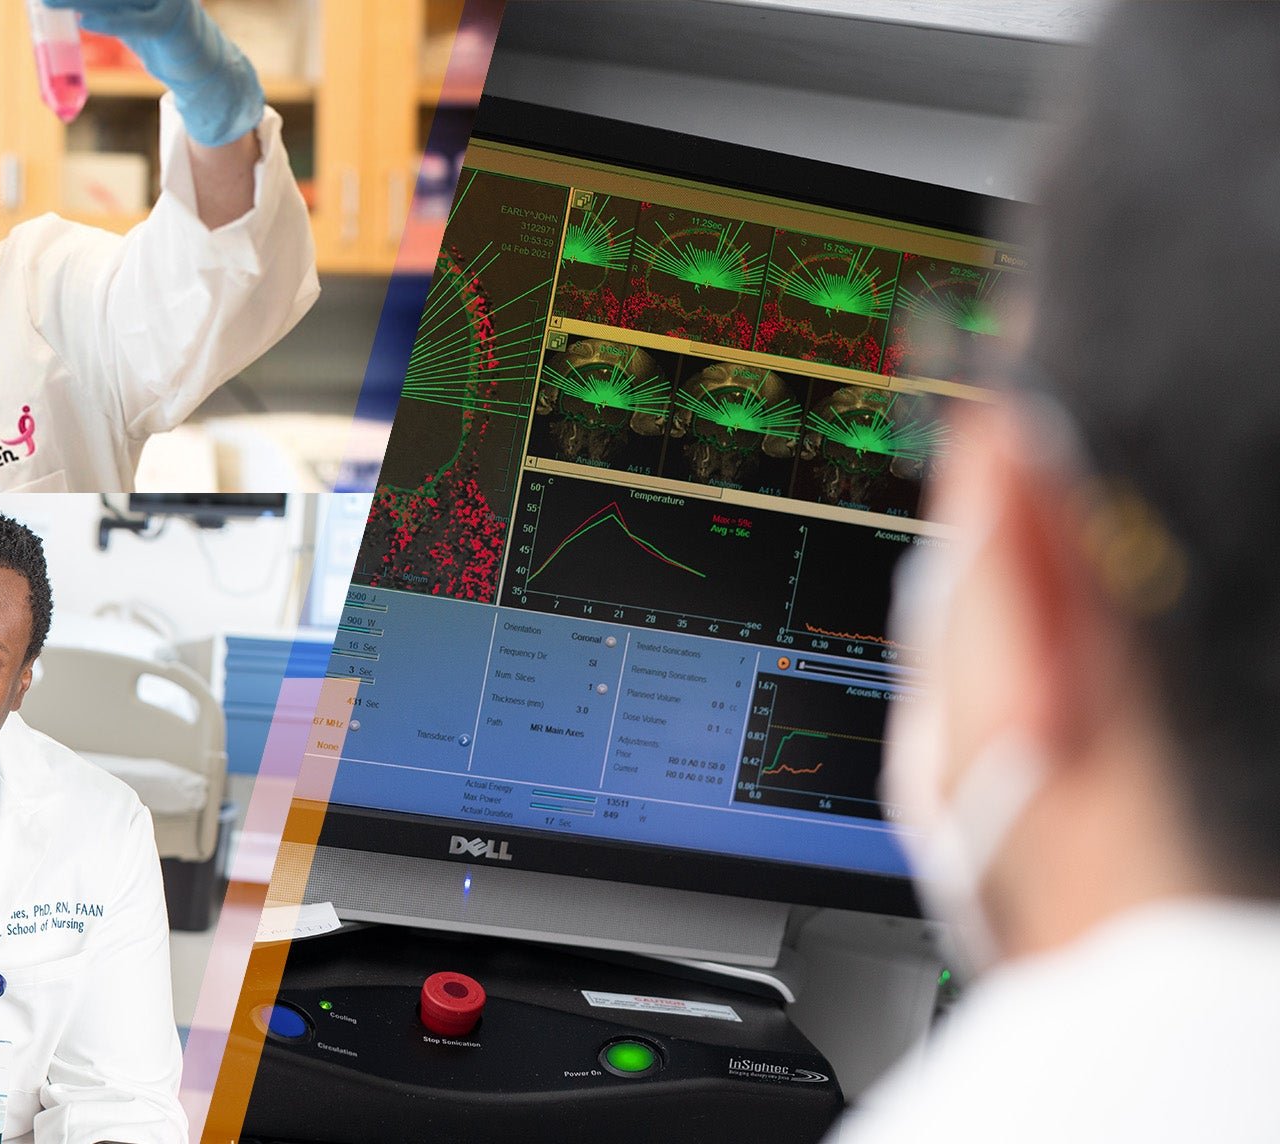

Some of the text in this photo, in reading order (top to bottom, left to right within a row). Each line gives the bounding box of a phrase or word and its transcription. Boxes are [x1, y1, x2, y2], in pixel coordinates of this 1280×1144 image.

[521, 222, 555, 234] 3122971
[520, 234, 554, 247] 10:53:59
[501, 243, 551, 259] 04 Feb 2021
[531, 483, 540, 492] 60
[629, 489, 685, 506] Temperature
[527, 503, 537, 512] 55
[712, 513, 729, 524] Max
[523, 524, 533, 533] 50
[711, 524, 751, 538] Avg 56c
[875, 530, 911, 544] Acoustic
[520, 545, 530, 554] 45
[516, 566, 526, 575] 40
[512, 586, 522, 595] 35
[521, 596, 750, 638] 0 7 14 21 28 35 42 49
[504, 622, 542, 635] Orientation
[747, 622, 762, 631] sec
[571, 632, 602, 643] Coronal
[500, 645, 536, 659] Frequency
[758, 680, 773, 690] 1.67
[846, 686, 881, 699] Acoustic
[417, 729, 455, 742] Transducer
[530, 723, 584, 738] MR Main Axes
[449, 835, 512, 861] DELL
[75, 903, 104, 917] FAAN
[7, 918, 84, 935] School of Nursing
[330, 1011, 357, 1025] Cooling
[423, 1036, 481, 1048] Stop Sonication
[317, 1042, 358, 1057] Circulation
[728, 1057, 789, 1075] InSightec
[564, 1069, 602, 1078] Power On
